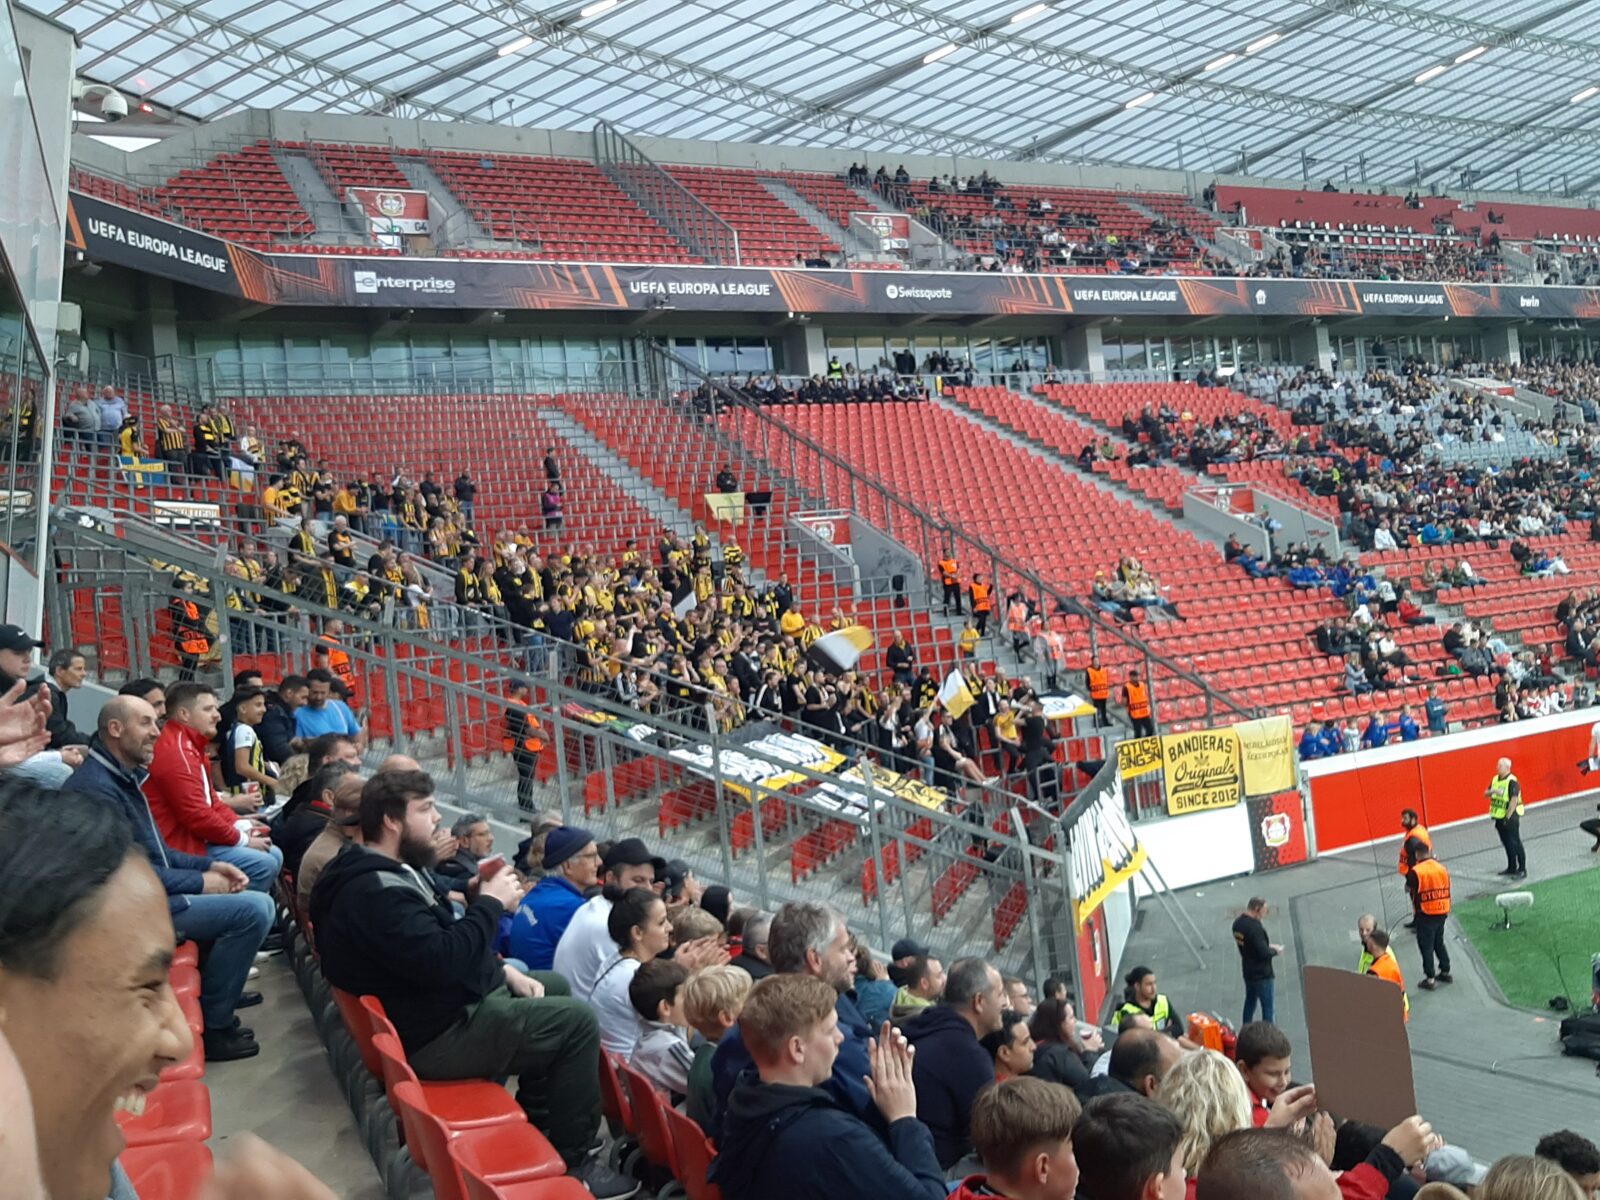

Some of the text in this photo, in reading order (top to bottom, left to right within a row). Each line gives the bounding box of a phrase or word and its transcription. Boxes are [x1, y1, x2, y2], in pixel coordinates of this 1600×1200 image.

[88, 217, 227, 273] UEFA EUROPA LEAGUE
[357, 274, 456, 292] enterprise
[630, 281, 770, 297] UEFA EUROPA LEAGUE
[898, 286, 953, 301] Swissquote
[1073, 289, 1177, 302] UEFA EUROPA LEAGUE
[1363, 293, 1444, 305] UEFA EUROPA LEAGUE
[1520, 295, 1540, 308] bwin
[1168, 734, 1233, 763] BANDIERAS
[1174, 755, 1236, 788] Originals
[1176, 788, 1238, 809] SINCE 2012
